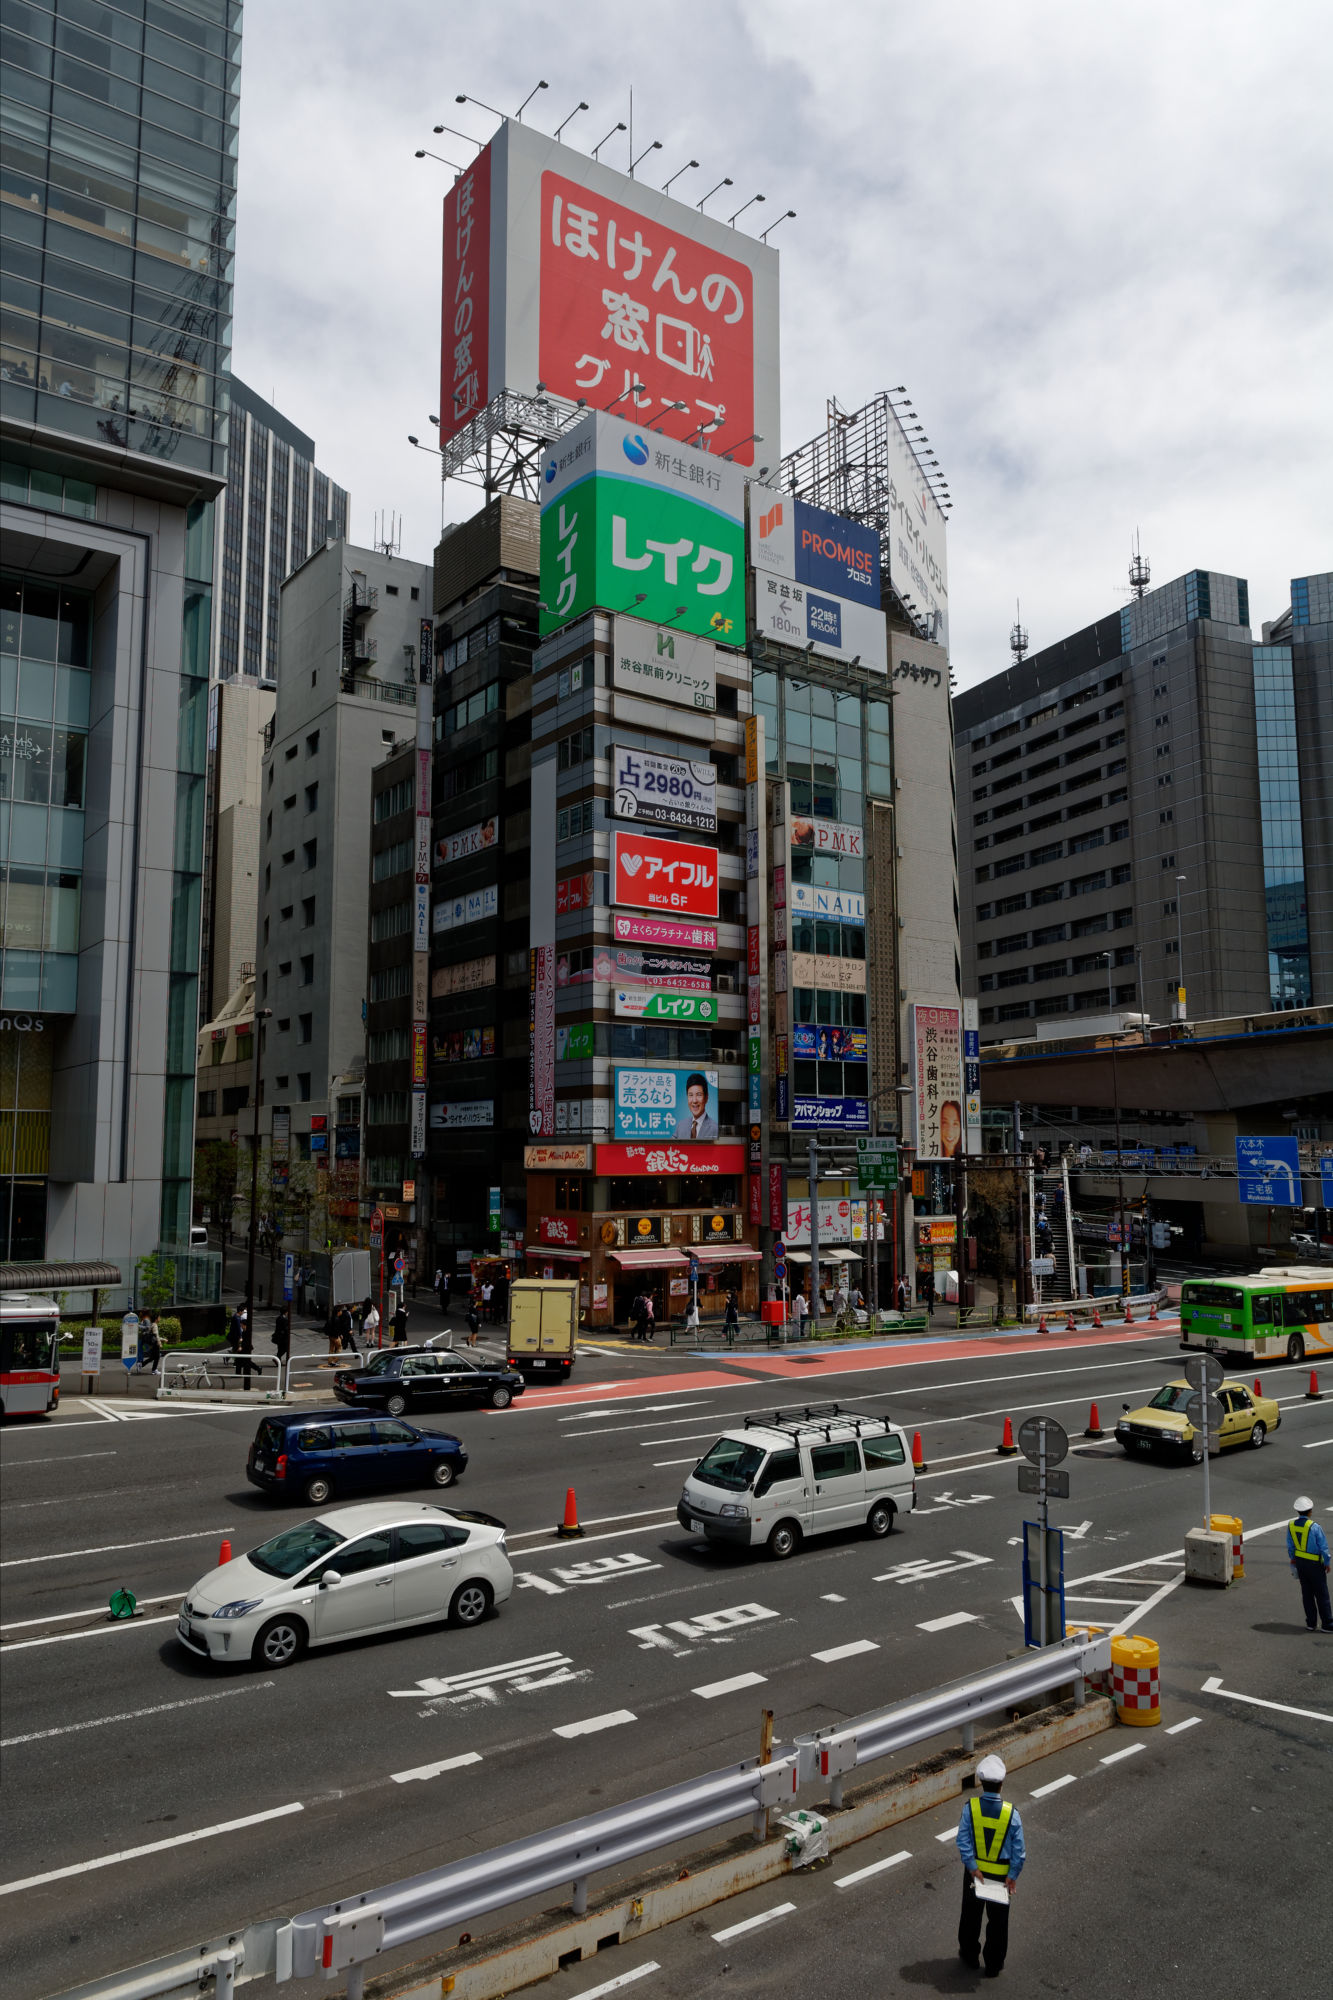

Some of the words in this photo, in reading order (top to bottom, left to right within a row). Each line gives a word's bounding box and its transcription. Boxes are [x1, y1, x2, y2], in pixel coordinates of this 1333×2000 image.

[552, 195, 744, 324] ほけんの
[575, 354, 726, 433] グループ
[559, 436, 592, 472] 新生銀行
[655, 450, 722, 492] 新生銀行
[557, 503, 578, 617] レイク
[612, 514, 734, 596] レイク
[802, 529, 873, 574] PROMISE
[847, 568, 873, 586] プロミス
[767, 580, 803, 603] 宮益坂
[770, 615, 800, 636] 180m
[620, 657, 710, 691] 渋谷駅前クリニック
[619, 795, 633, 814] 7F
[655, 808, 715, 829] 03-6434-1212
[452, 835, 478, 858] PMK
[818, 829, 860, 854] PMK
[418, 842, 427, 872] PMK
[644, 856, 714, 888] アイフル
[469, 891, 496, 910] NAIL
[648, 893, 669, 904] 当ビル
[670, 893, 688, 907] 6F
[818, 894, 864, 916] NAIL
[418, 903, 426, 934] NAIL
[632, 924, 715, 946] さくらプラチナム歯科
[749, 929, 758, 972] アイフル
[653, 977, 711, 990] 03-6452-6588
[657, 997, 696, 1016] レイク
[543, 947, 554, 1135] さくらプラチナム歯科
[569, 1035, 590, 1048] レイク
[623, 1075, 672, 1087] ブランド品を
[925, 1026, 939, 1157] 渋谷歯科タナカ
[623, 1087, 673, 1104] 売るなら
[531, 1114, 540, 1128] 5F
[618, 1111, 677, 1129] なんぼや
[795, 1104, 843, 1118] アパマンショップ
[750, 1142, 760, 1151] 2F
[1239, 1139, 1265, 1150] 六本木
[645, 1147, 689, 1173] 銀だこ
[1247, 1184, 1274, 1195] 三宅坂
[285, 1256, 293, 1274] P
